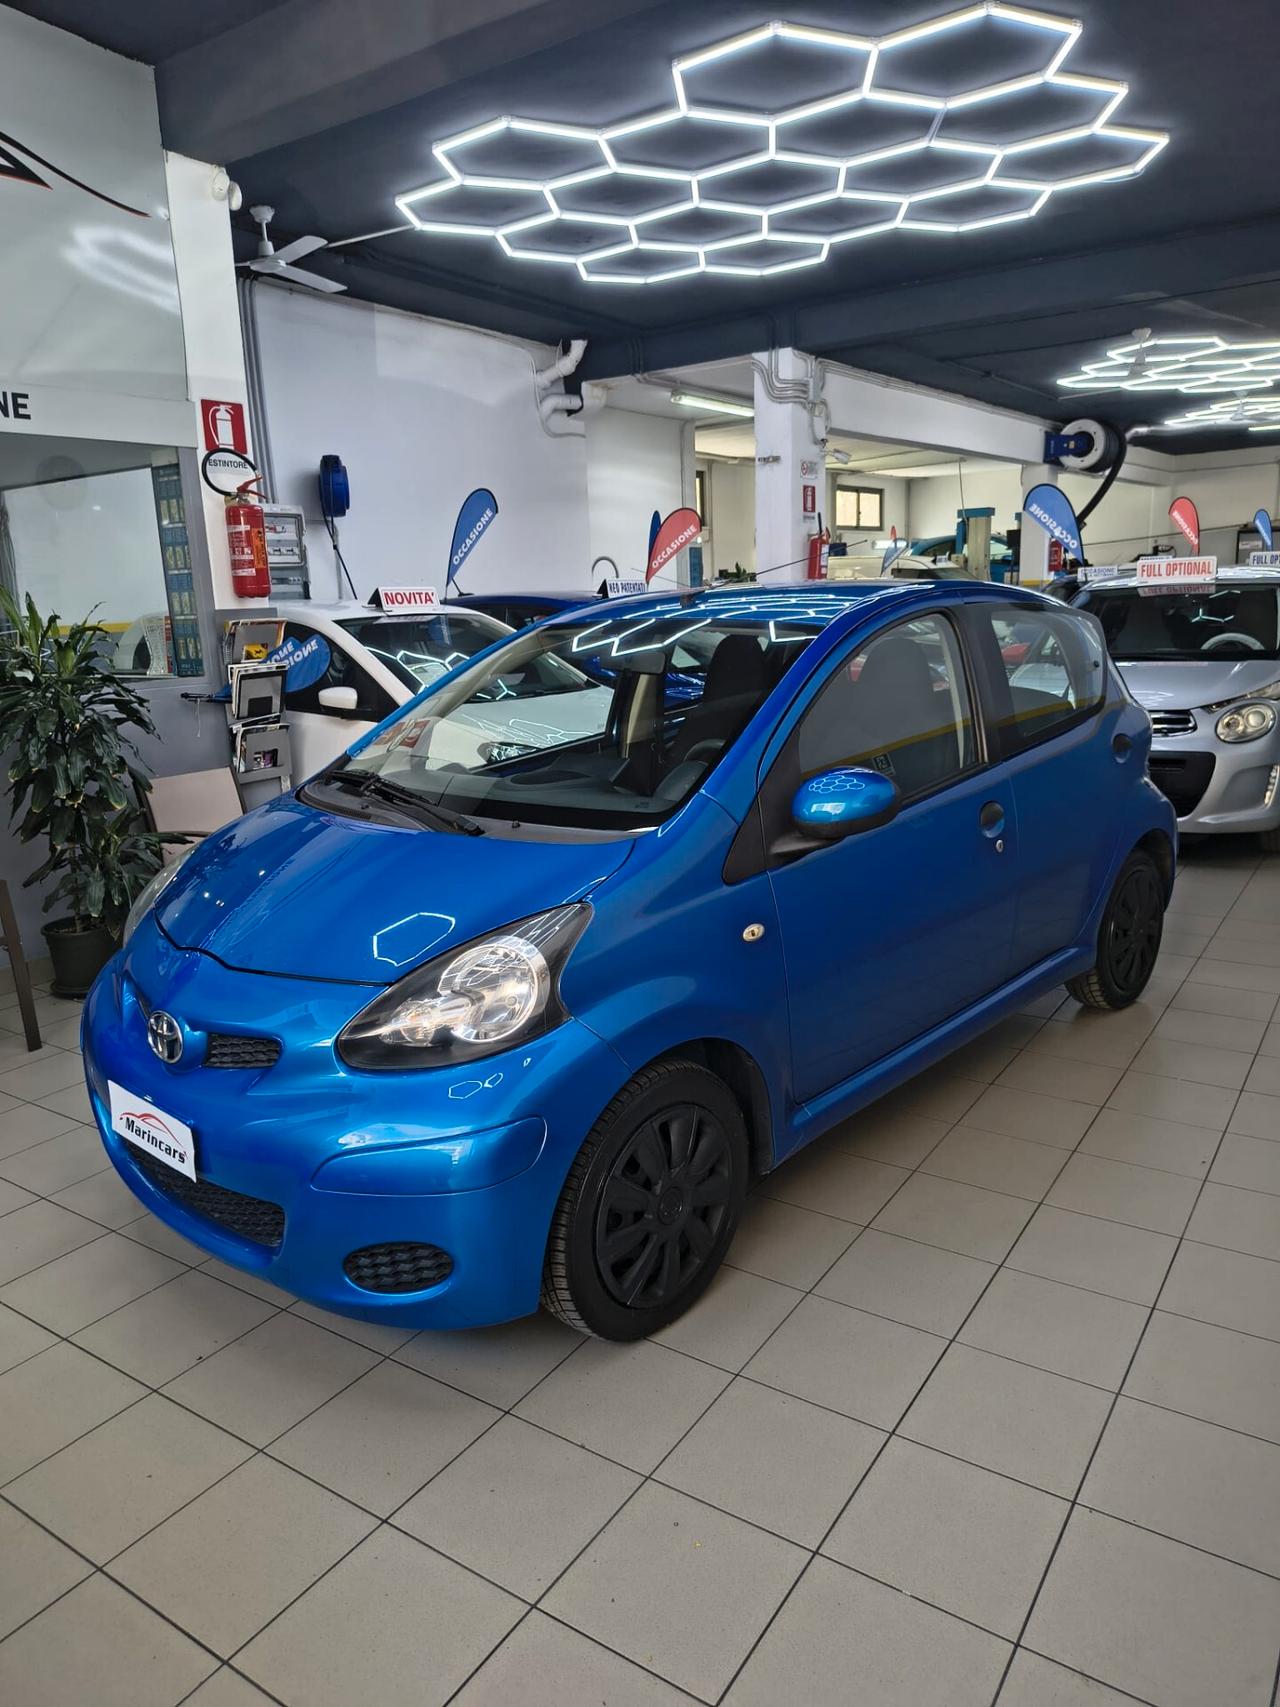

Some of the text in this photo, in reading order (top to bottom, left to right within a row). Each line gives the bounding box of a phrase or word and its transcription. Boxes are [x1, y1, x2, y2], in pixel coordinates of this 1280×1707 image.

[208, 459, 248, 469] ESTINTORE
[453, 508, 493, 565] OCCASIONE
[652, 525, 698, 568] OCCASIONE
[1252, 555, 1280, 564] FULL OP
[1141, 561, 1212, 577] FULL OPTIONAL
[384, 592, 434, 605] NOVITA'
[125, 1117, 186, 1164] Marincars
